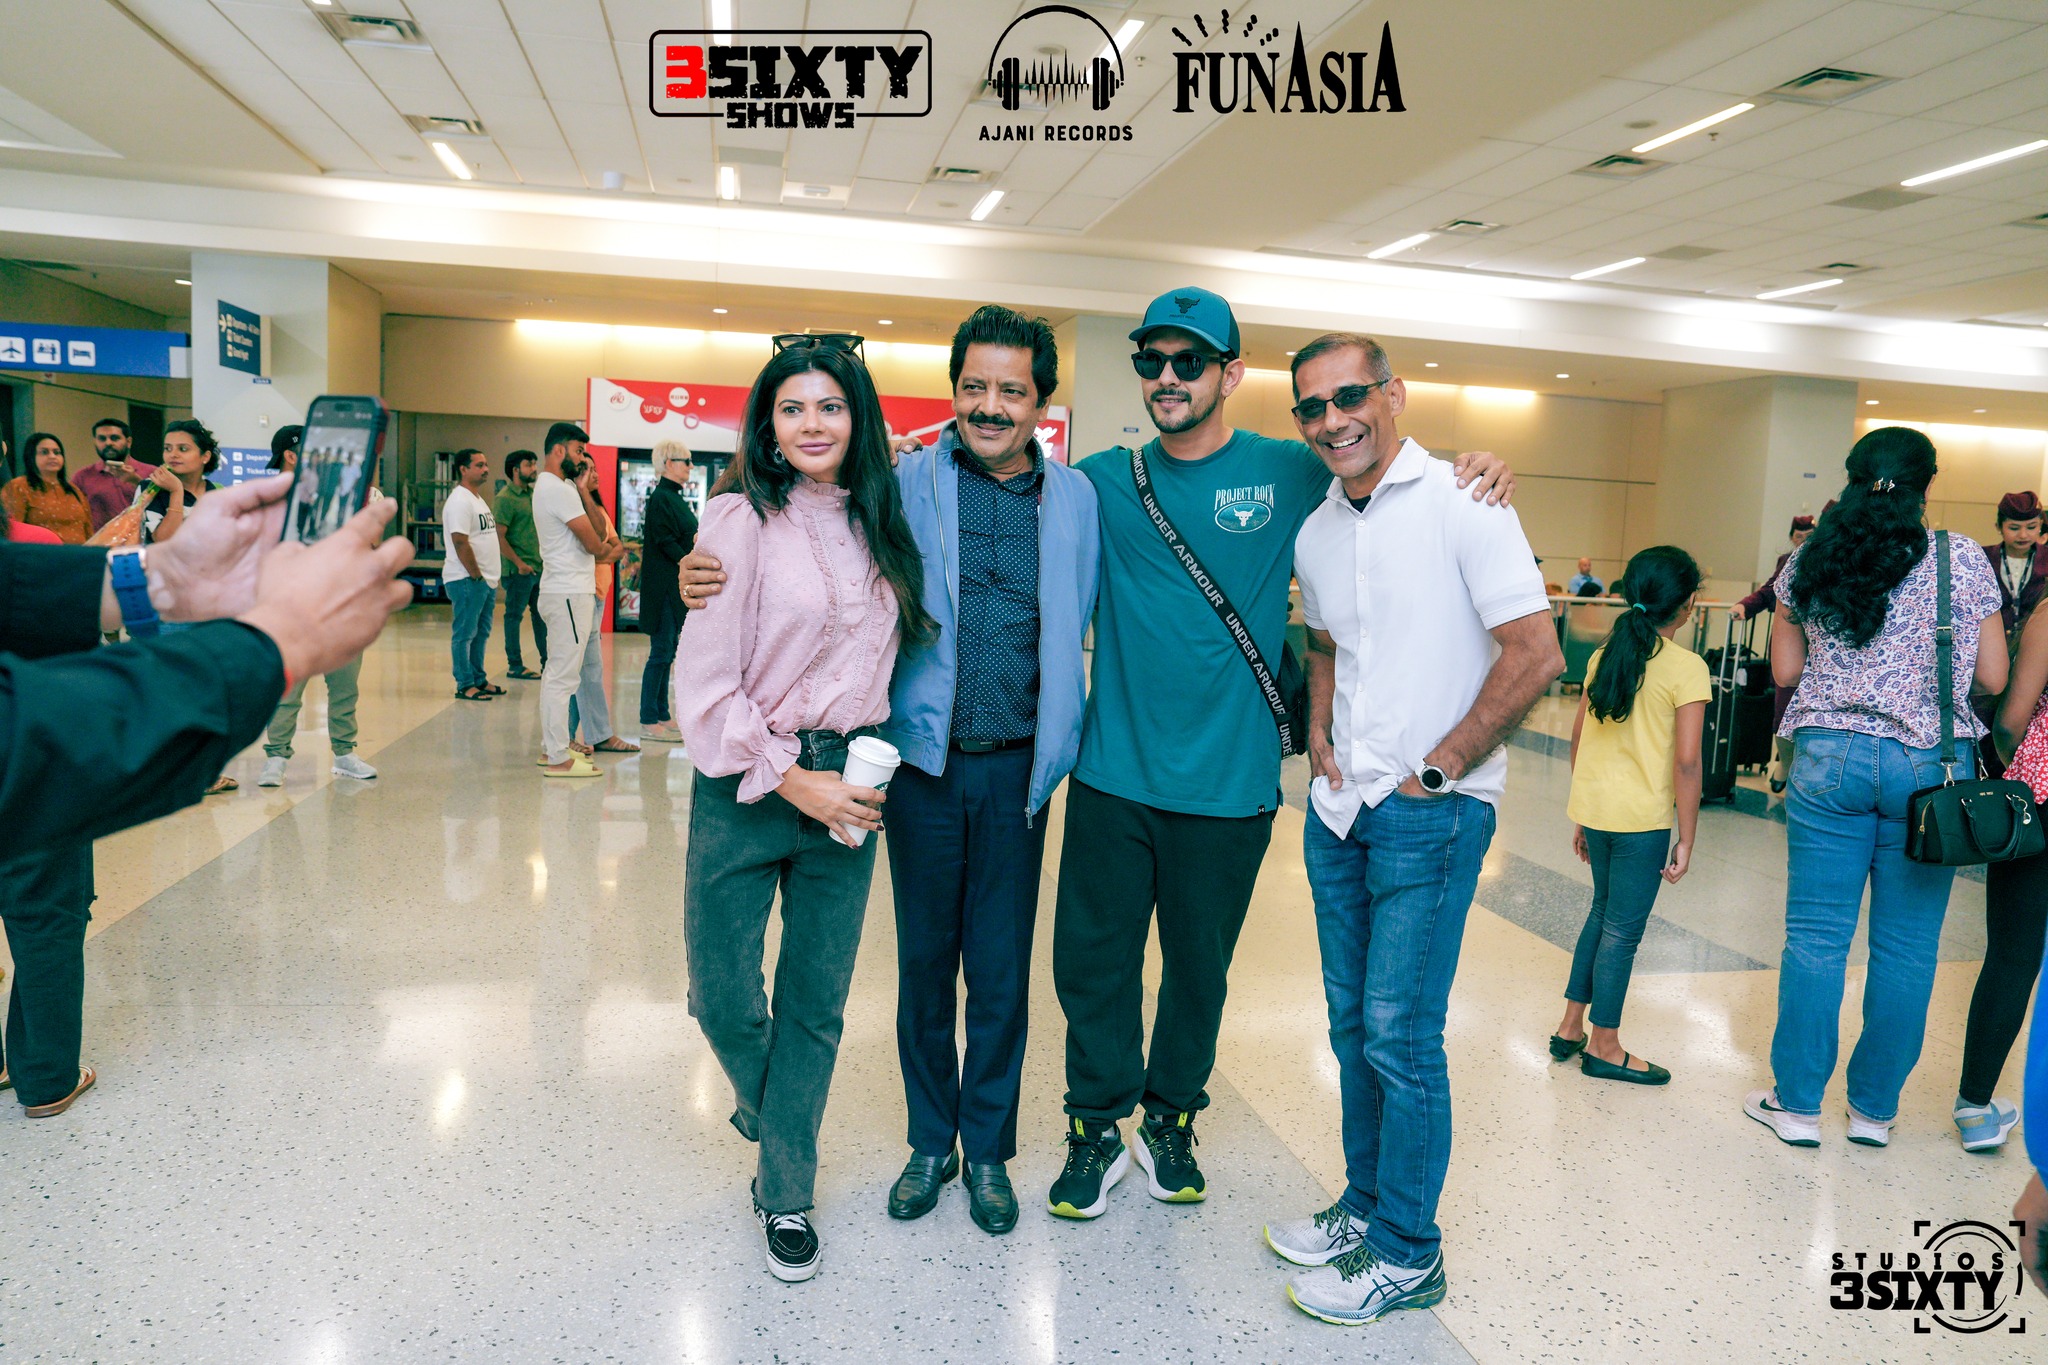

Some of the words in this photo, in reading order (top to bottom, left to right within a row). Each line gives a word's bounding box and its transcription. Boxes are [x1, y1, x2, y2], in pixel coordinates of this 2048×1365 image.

[1214, 486, 1252, 511] PROJECT
[1254, 484, 1276, 508] ROCK
[1143, 493, 1177, 544] UNDER
[1173, 544, 1224, 608] ARMOUR
[1225, 612, 1258, 662] UNDER
[1253, 662, 1286, 716] ARMOUR
[1279, 723, 1293, 758] UNDE
